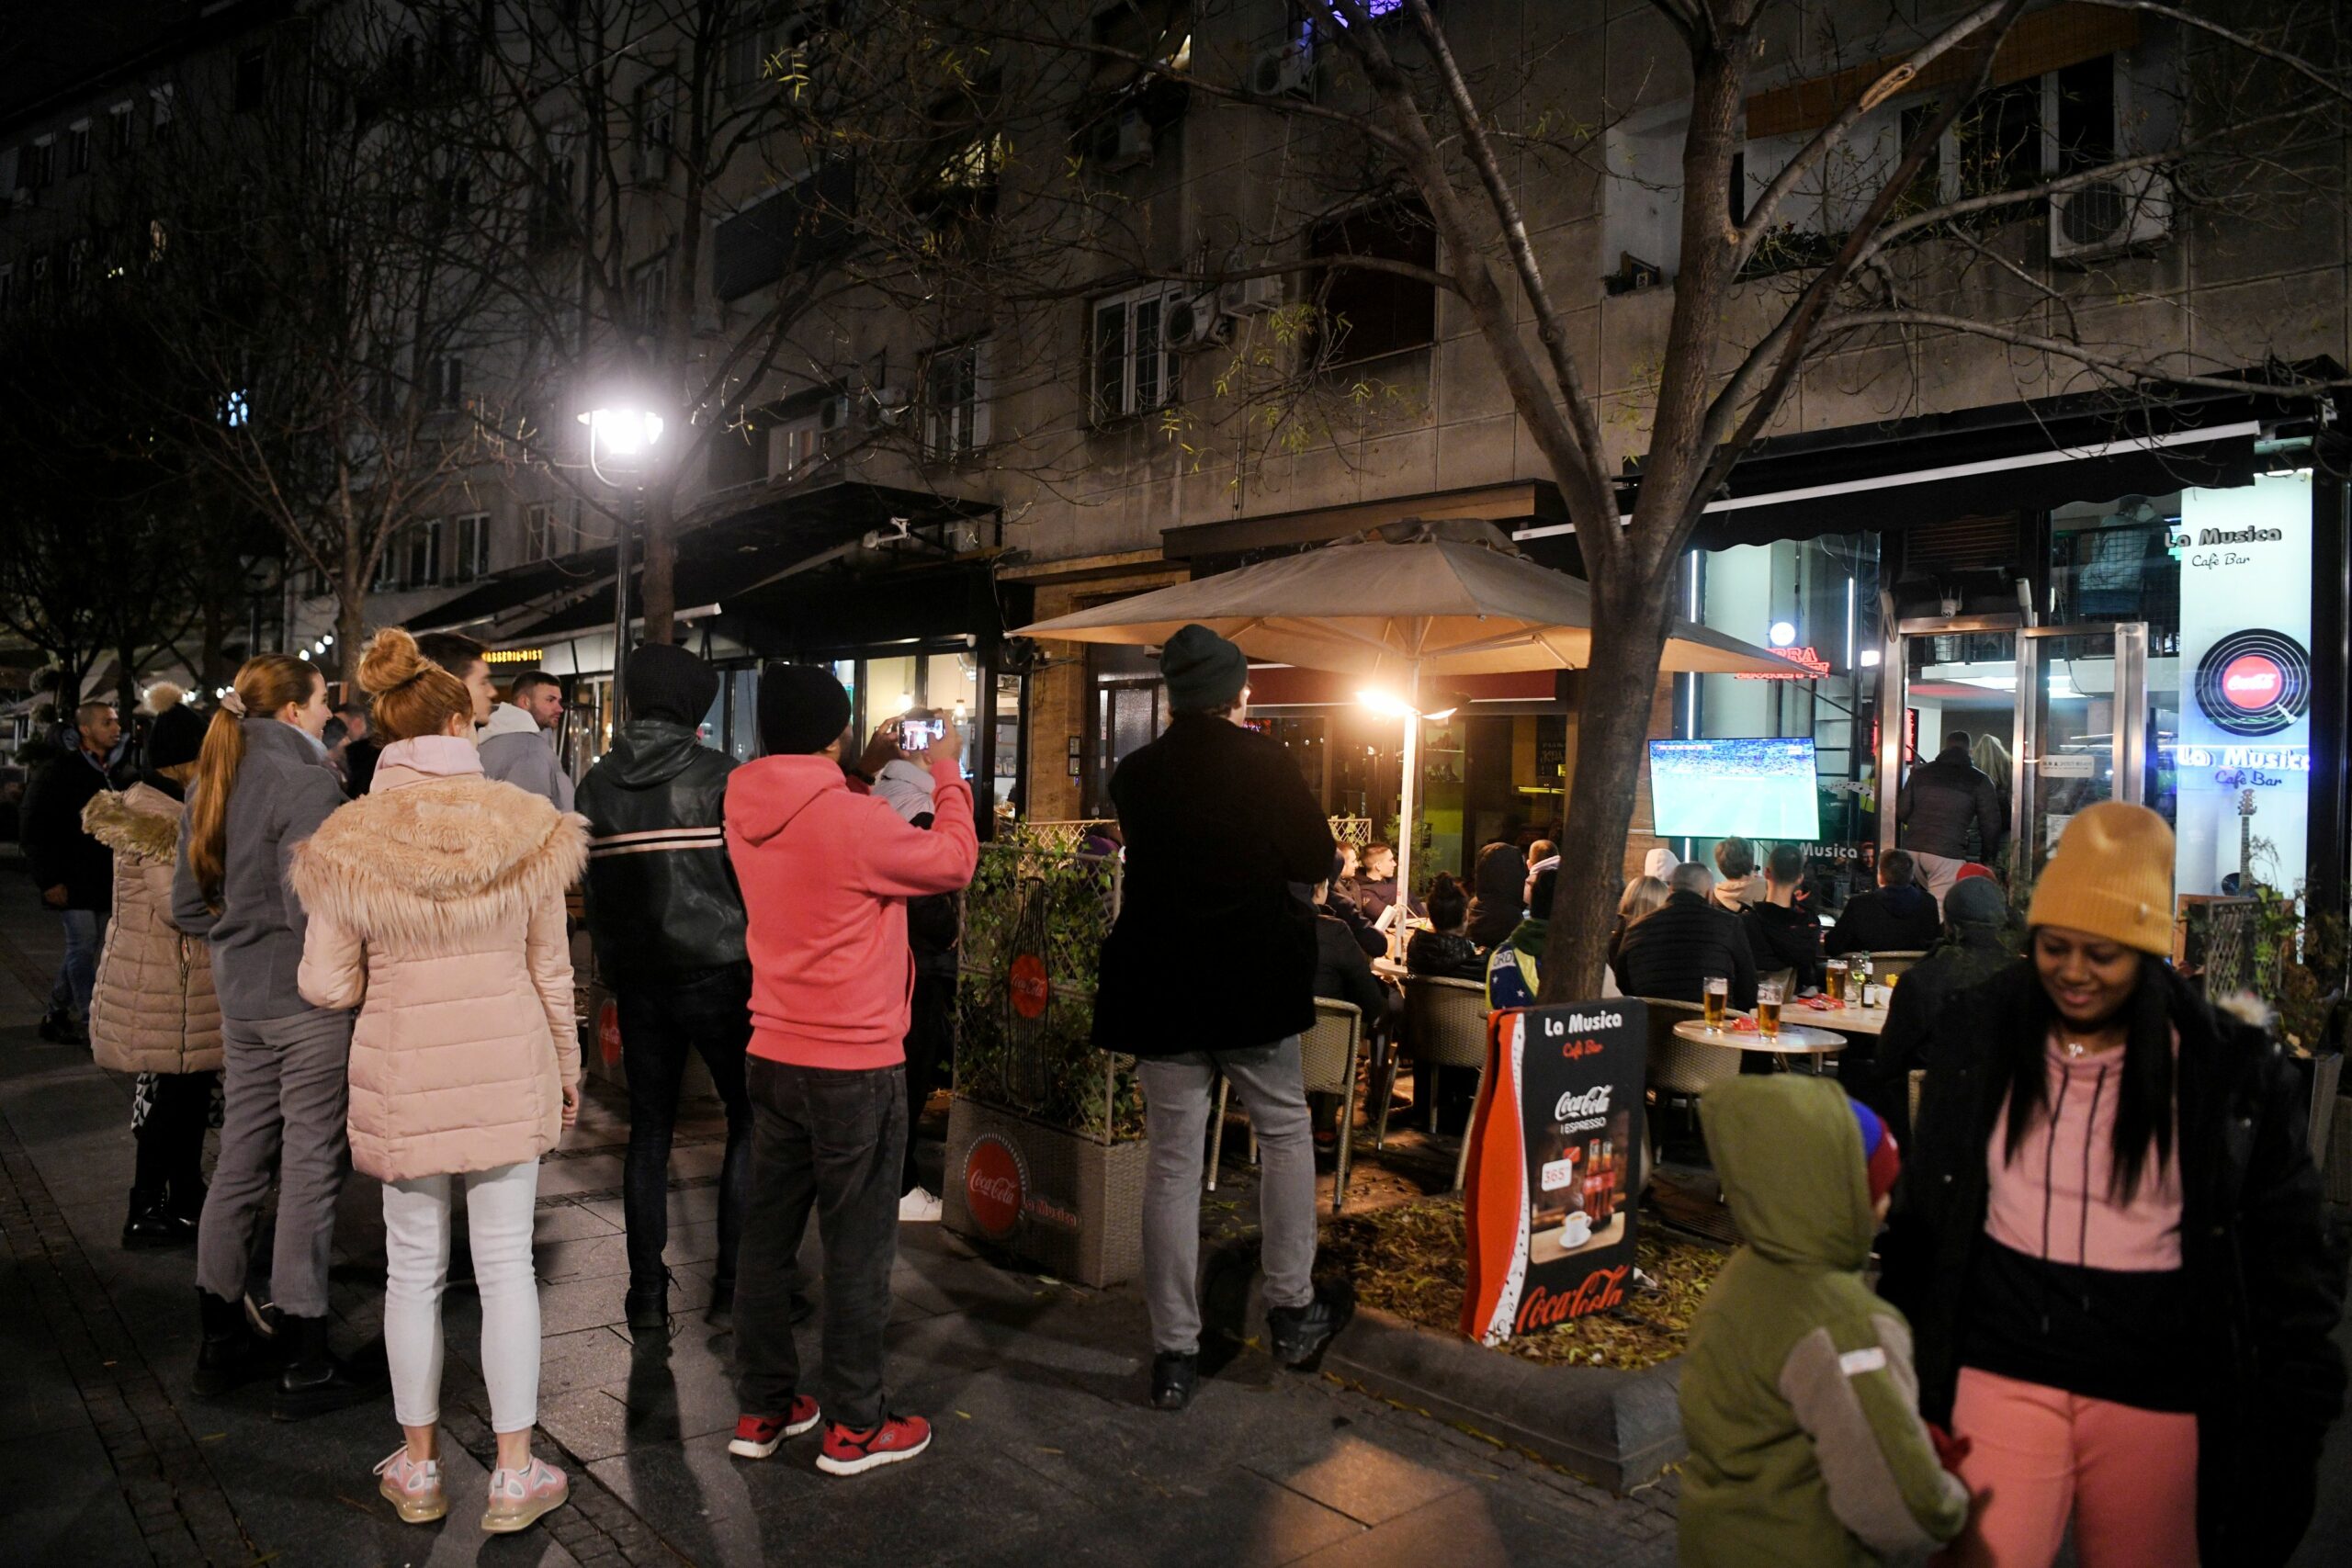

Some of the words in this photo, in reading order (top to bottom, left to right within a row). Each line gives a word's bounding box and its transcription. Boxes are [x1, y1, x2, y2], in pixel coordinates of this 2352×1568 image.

[2164, 531, 2191, 548] La
[2199, 525, 2282, 547] Musica
[2223, 552, 2251, 566] Bar
[2177, 745, 2212, 767] La
[2249, 771, 2283, 787] Bar
[1799, 841, 1858, 859] Musica
[1544, 1017, 1565, 1037] La
[1567, 1010, 1623, 1034] Musica
[1564, 1116, 1607, 1134] ESPRESSO
